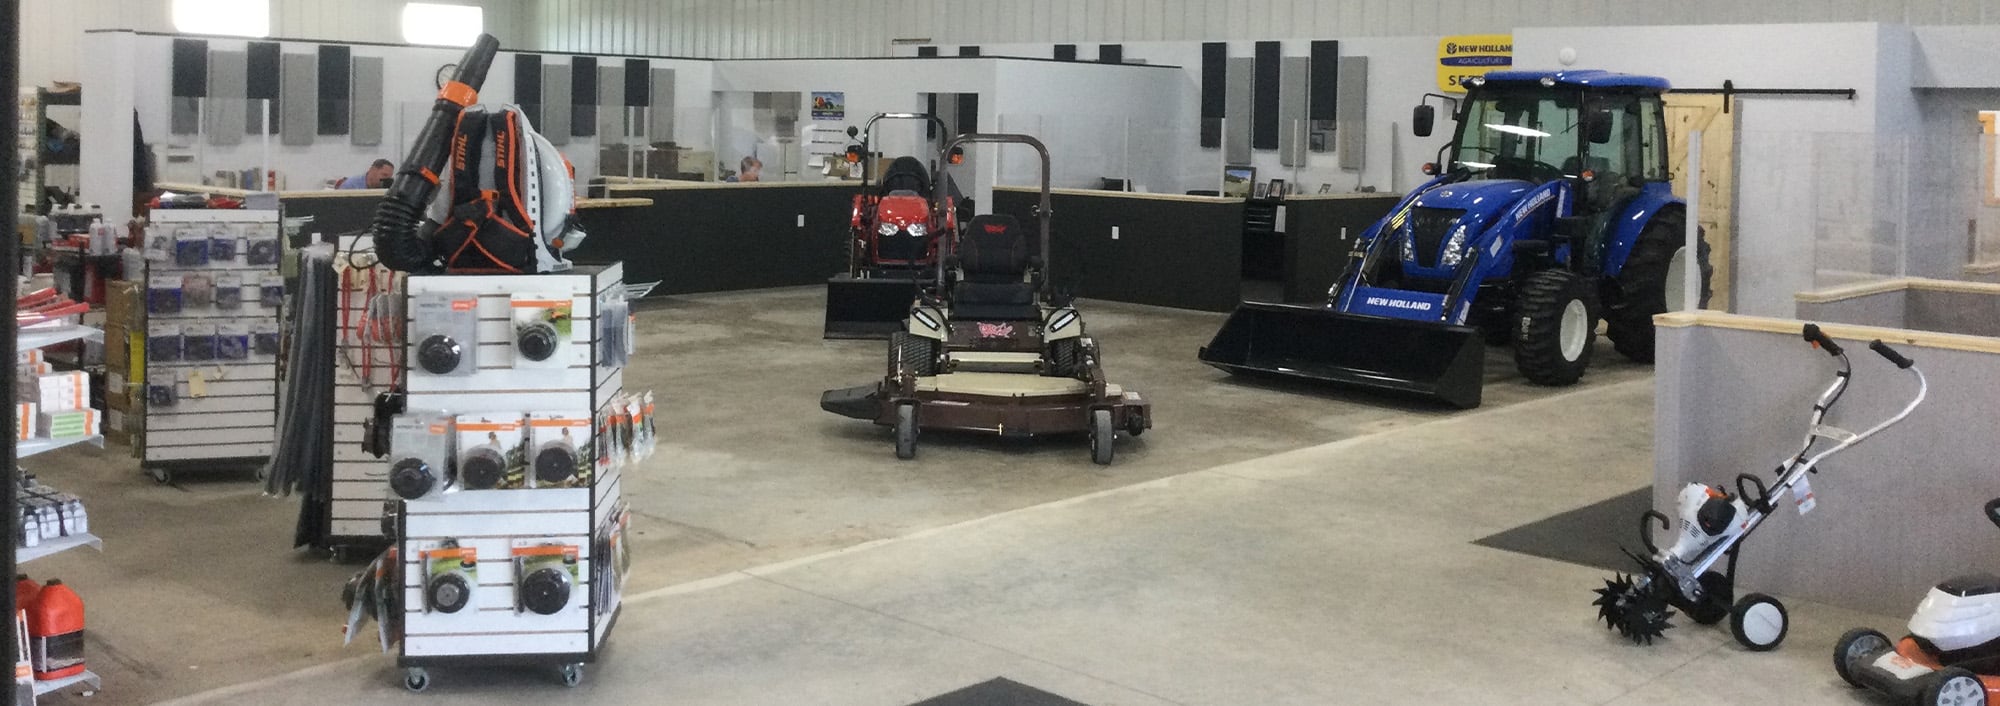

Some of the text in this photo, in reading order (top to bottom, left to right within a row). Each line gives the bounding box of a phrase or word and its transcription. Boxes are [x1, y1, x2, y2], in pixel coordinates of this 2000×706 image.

[1458, 44, 1513, 53] NEW HOLLAN
[456, 133, 468, 171] STIHL
[496, 129, 506, 169] STIHL
[1366, 296, 1431, 311] NEW HOLLAND
